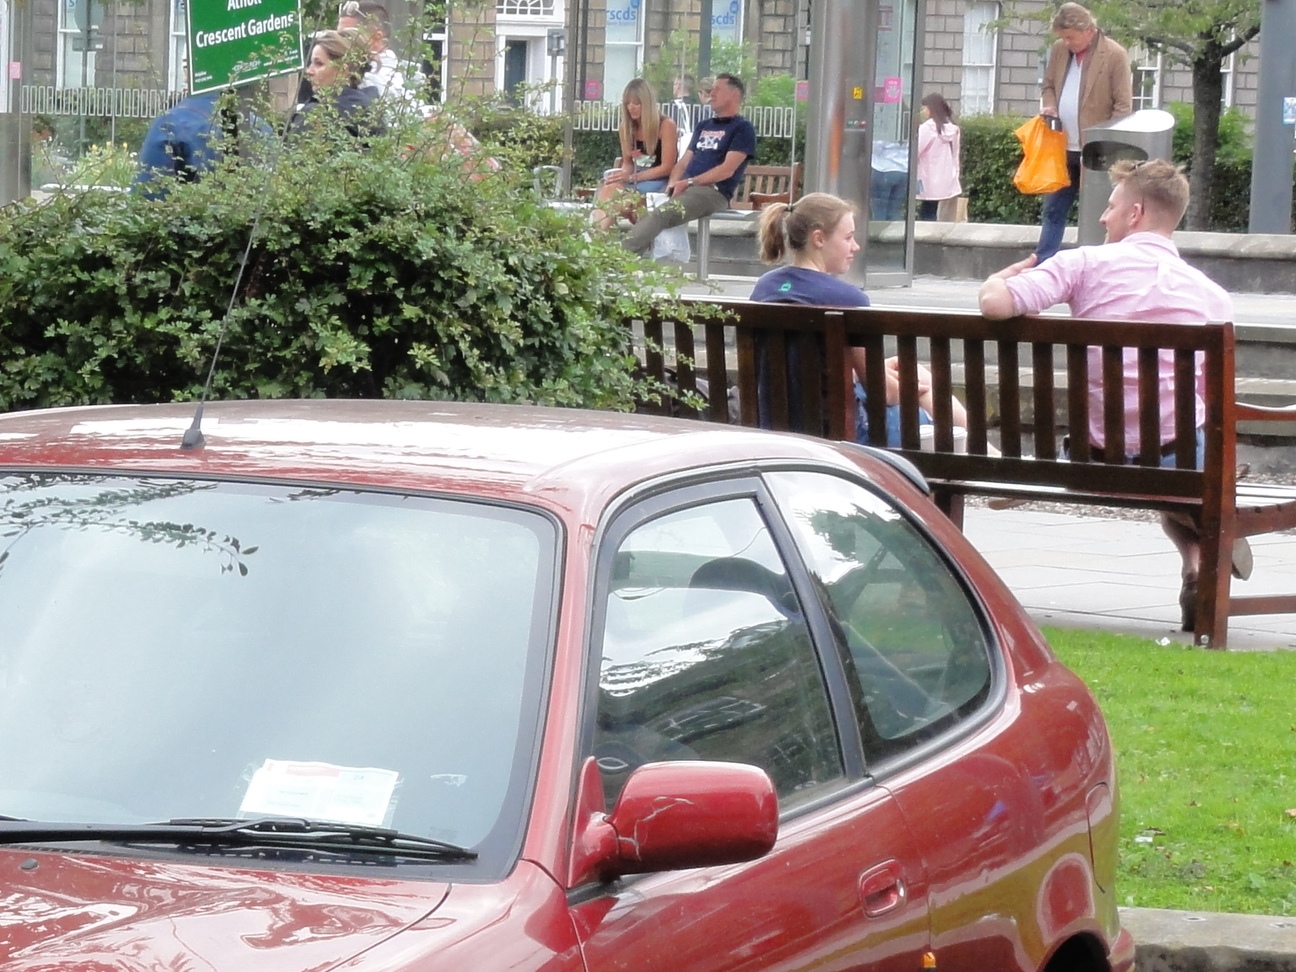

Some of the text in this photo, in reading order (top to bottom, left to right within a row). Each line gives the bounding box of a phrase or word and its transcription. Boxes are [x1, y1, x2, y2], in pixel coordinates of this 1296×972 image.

[227, 0, 262, 11] Atho
[195, 14, 294, 48] Crescent Gardens
